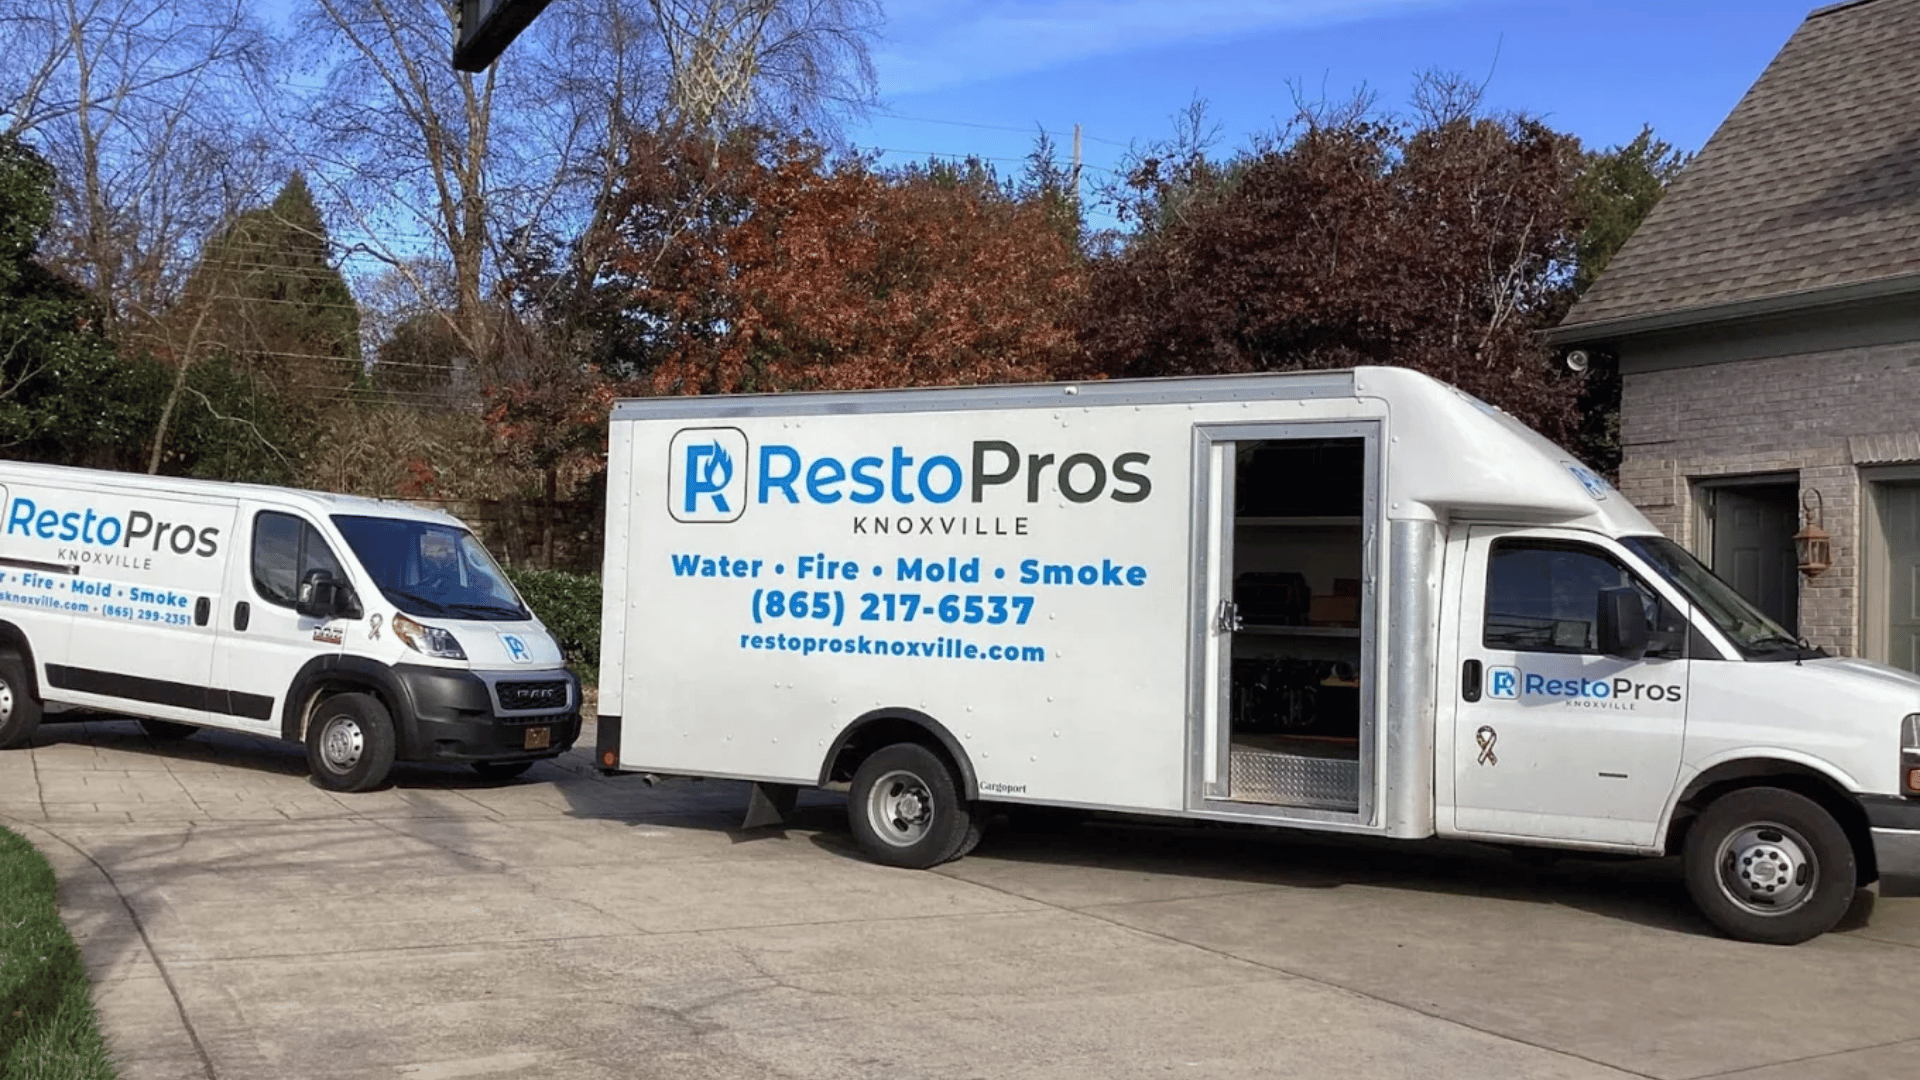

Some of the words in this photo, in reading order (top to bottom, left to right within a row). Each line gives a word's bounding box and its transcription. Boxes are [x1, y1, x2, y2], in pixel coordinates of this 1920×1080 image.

[758, 440, 1153, 504] RestoPros
[7, 497, 220, 558] RestoPros
[853, 516, 1030, 536] KNOXVILLE
[57, 548, 152, 570] KNOXVILLE
[671, 554, 763, 579] Water
[797, 553, 860, 580] Fire
[897, 557, 980, 583] Mold
[1019, 558, 1148, 586] Smoke
[22, 573, 54, 589] Fire
[71, 579, 112, 597] Mold
[129, 587, 188, 608] Smoke
[102, 604, 134, 620] (865)
[137, 609, 192, 626] 299-2351
[751, 588, 846, 626] (865)
[860, 593, 1036, 626] 217-6537
[740, 632, 1046, 663] restoprosknoxville.com
[1525, 673, 1681, 702] RestoPros
[1565, 701, 1636, 711] KNOXVILLE
[979, 780, 1027, 794] Cargoport
